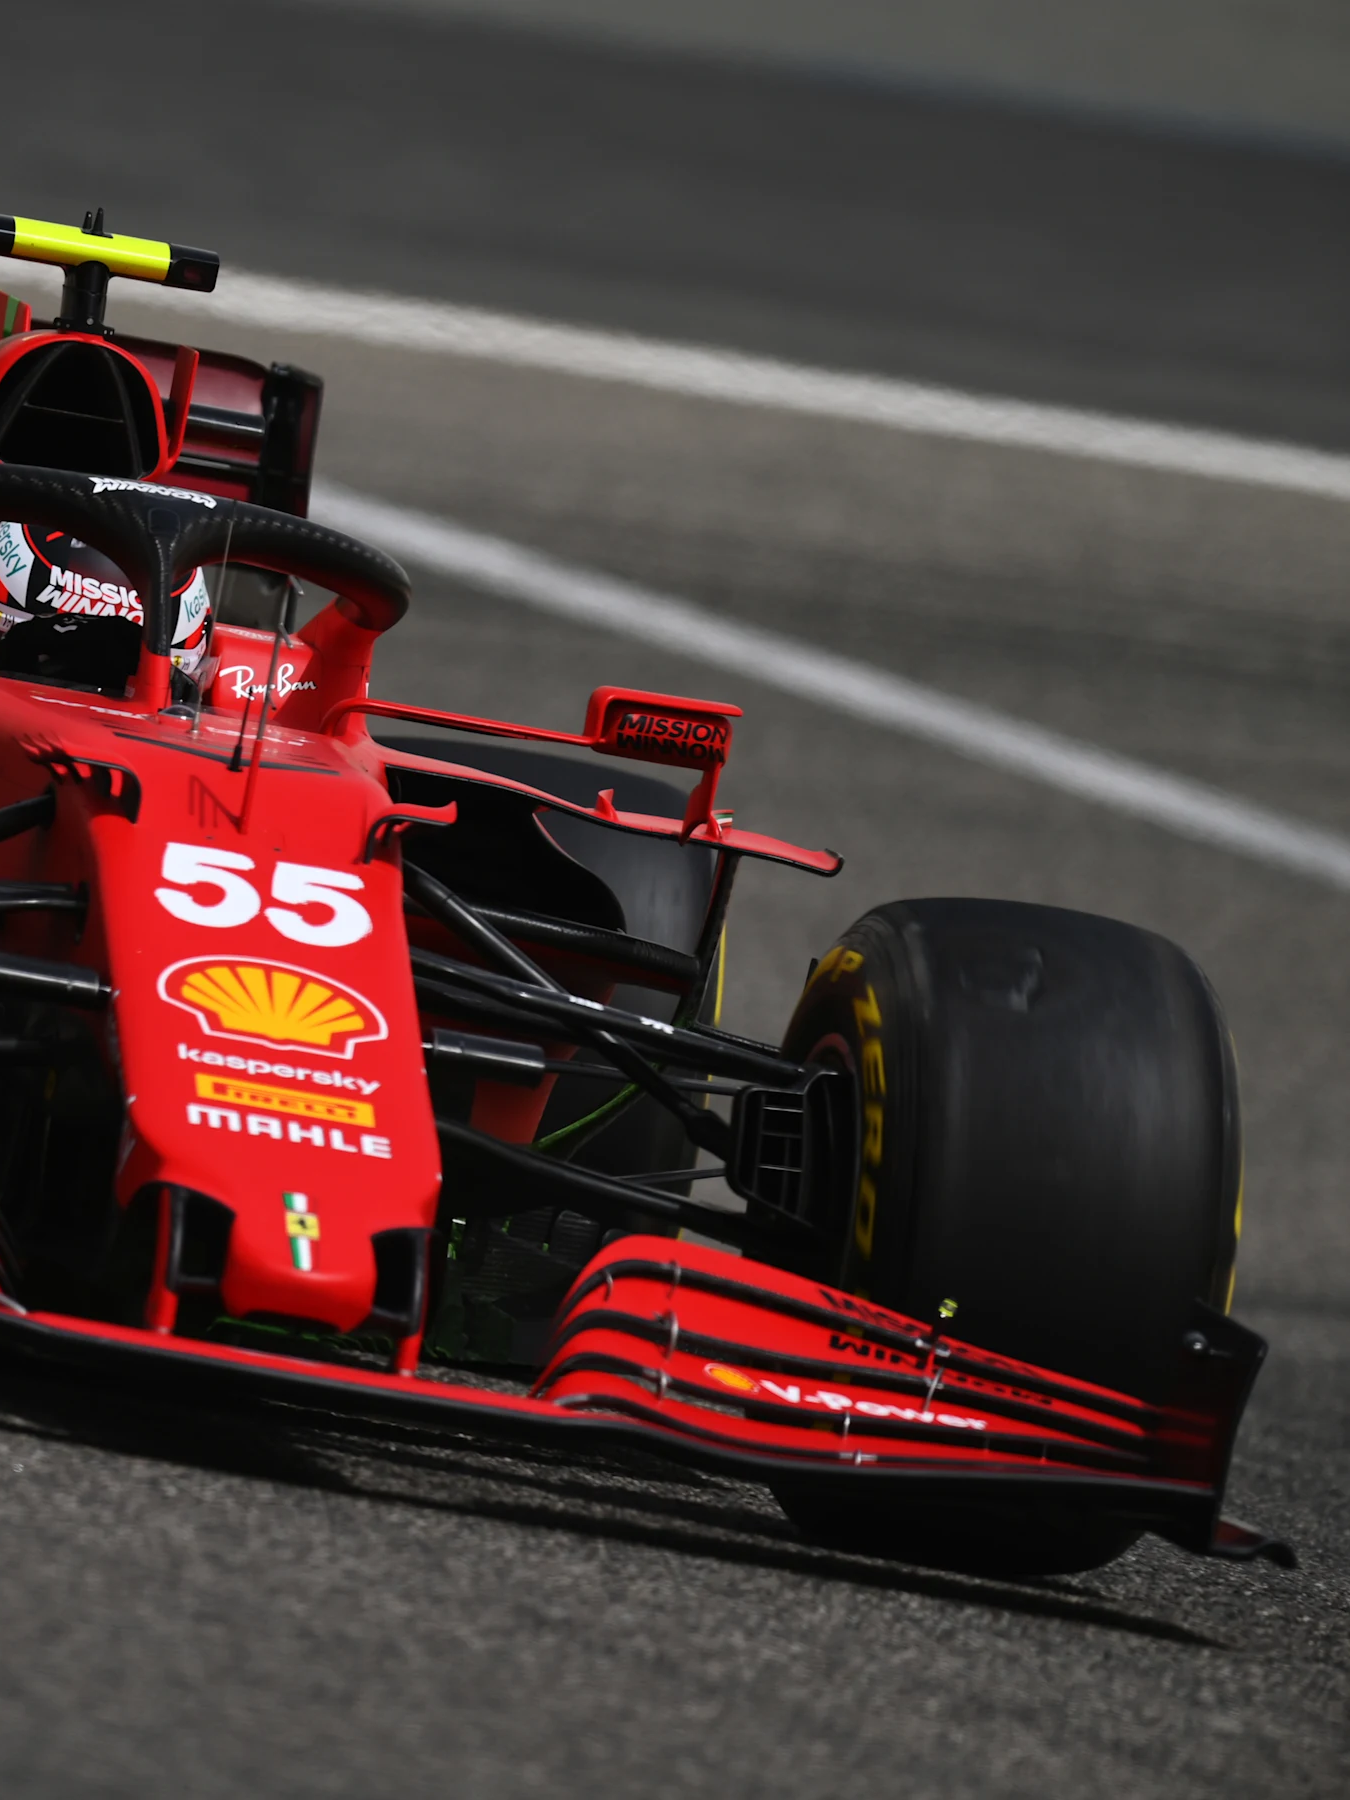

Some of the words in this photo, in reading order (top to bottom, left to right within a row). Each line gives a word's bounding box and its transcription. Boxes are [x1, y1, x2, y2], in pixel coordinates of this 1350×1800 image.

[218, 662, 318, 701] Ray-Ban
[616, 733, 725, 763] WINNOW
[617, 713, 728, 745] MISSION
[153, 841, 374, 948] 55
[176, 1042, 382, 1096] kaspersky
[185, 1102, 394, 1160] MAHLE
[852, 982, 887, 1262] ZERO
[757, 1379, 988, 1431] V-Power
